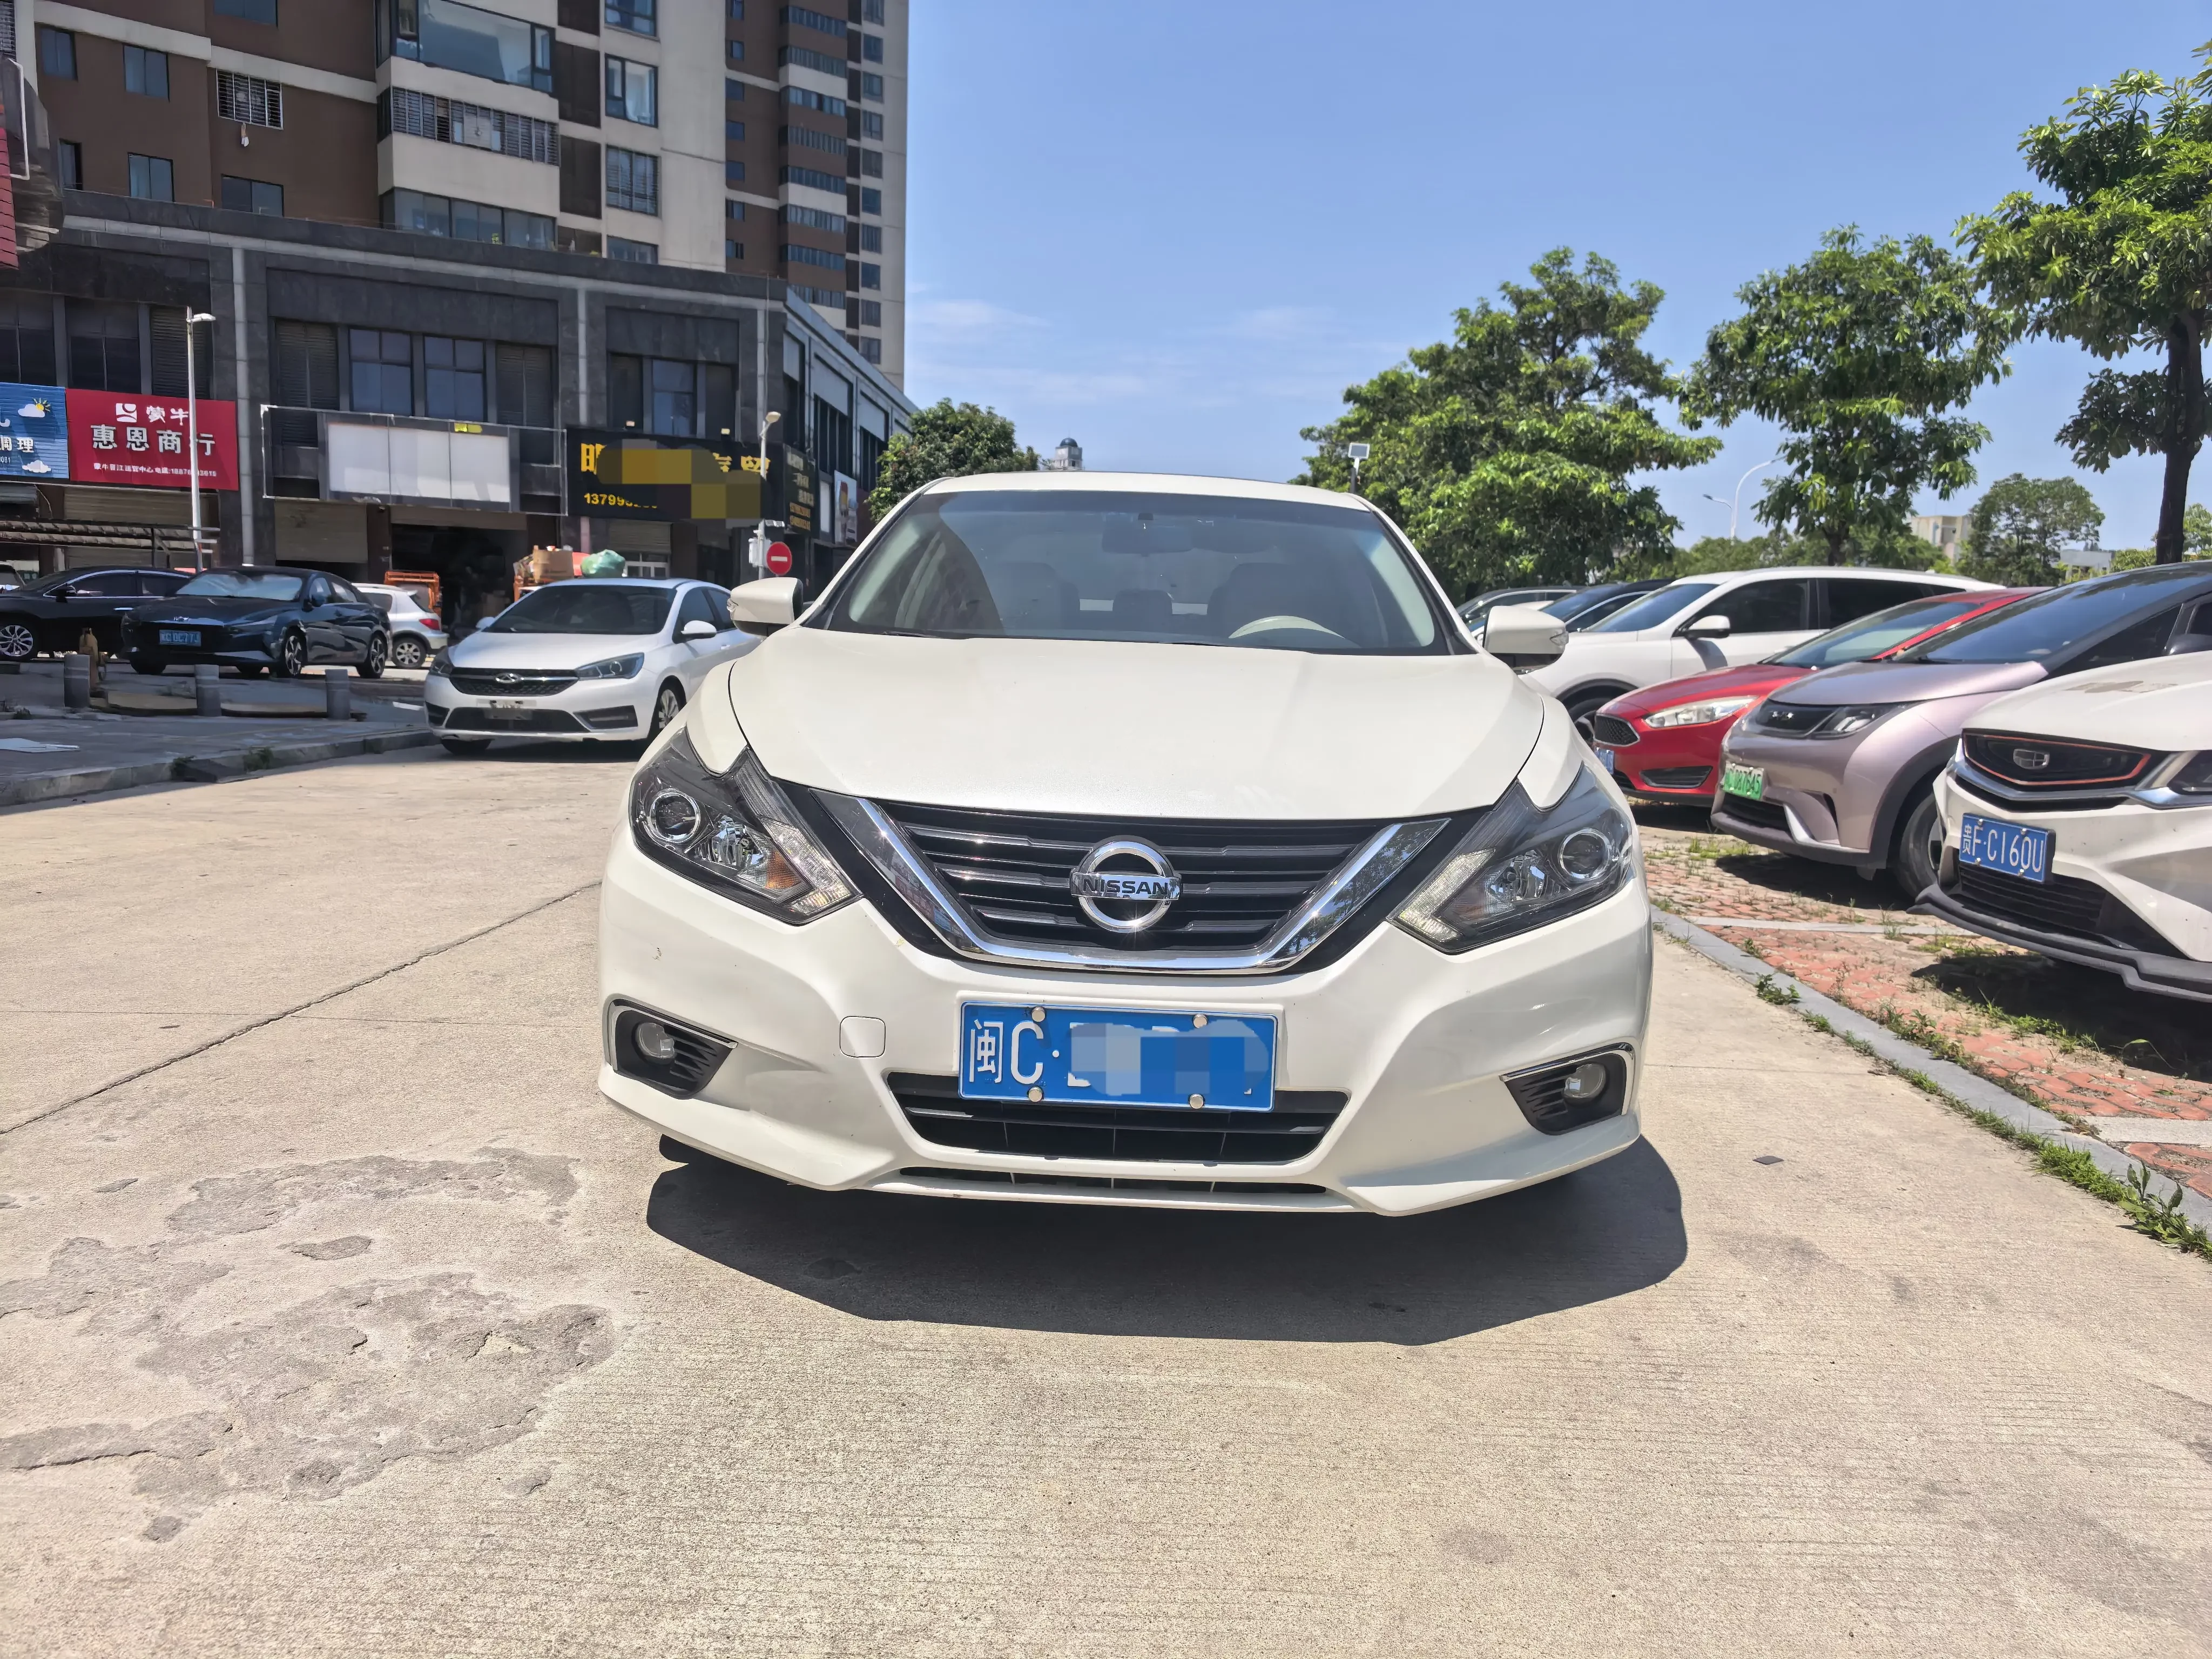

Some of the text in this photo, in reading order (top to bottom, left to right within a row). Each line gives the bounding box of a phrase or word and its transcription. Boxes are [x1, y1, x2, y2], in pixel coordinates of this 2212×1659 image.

[146, 406, 189, 426] 蒙牛
[90, 424, 215, 456] 惠恩商行
[1082, 878, 1169, 895] NISSAN
